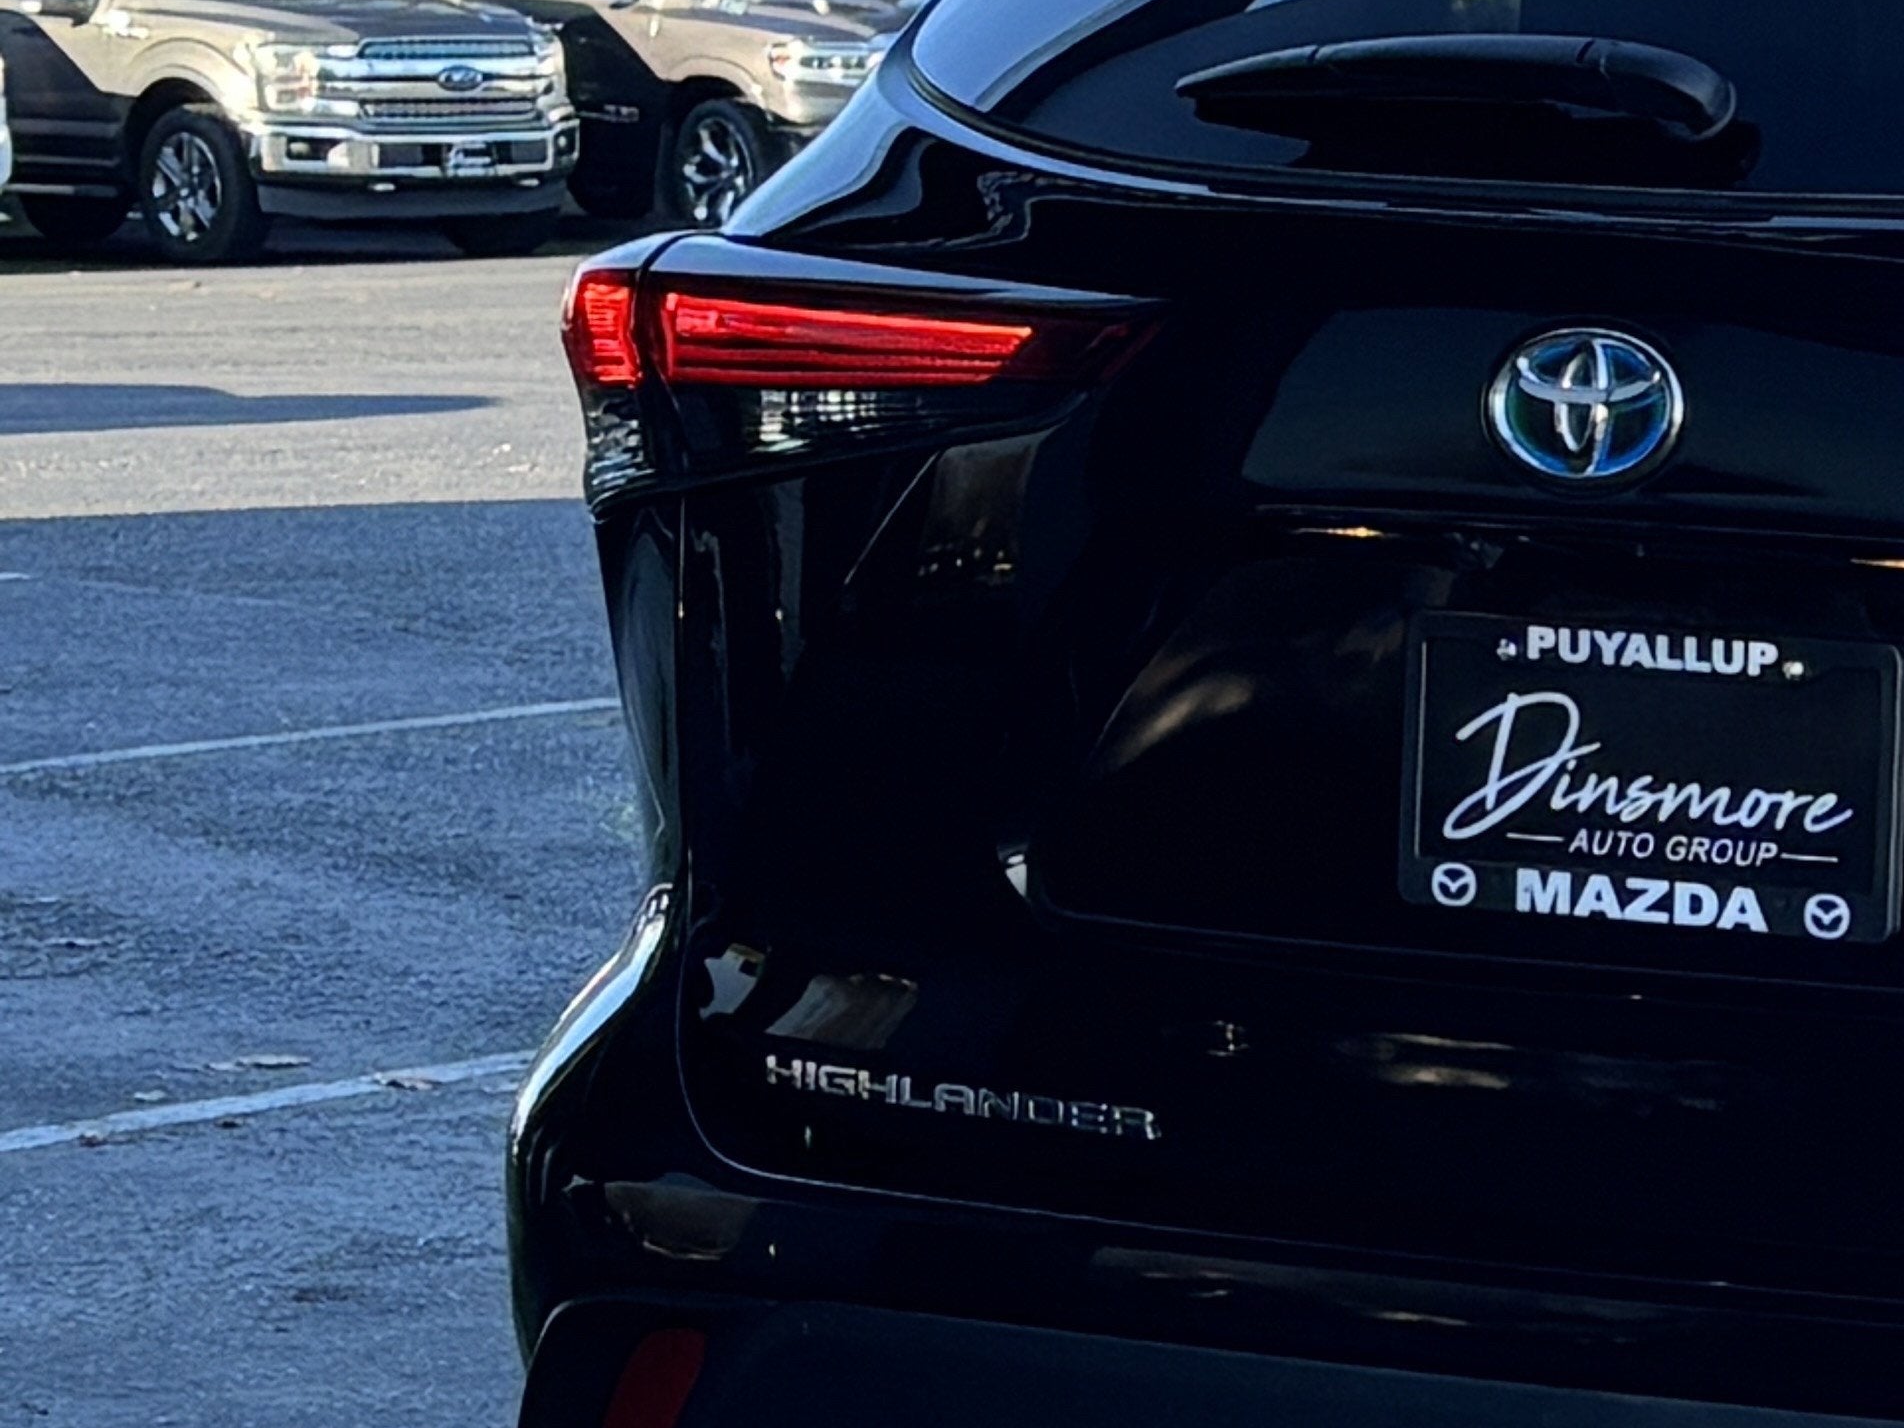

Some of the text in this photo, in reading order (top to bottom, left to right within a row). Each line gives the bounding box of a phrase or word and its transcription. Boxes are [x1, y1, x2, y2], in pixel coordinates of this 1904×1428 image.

[1526, 625, 1780, 676] PUYALLUP
[1442, 691, 1854, 839] Dinsmore
[1568, 828, 1780, 867] AUTO GROUP
[1515, 867, 1769, 933] MAZDA
[766, 1054, 1163, 1140] HIGHLANDER
